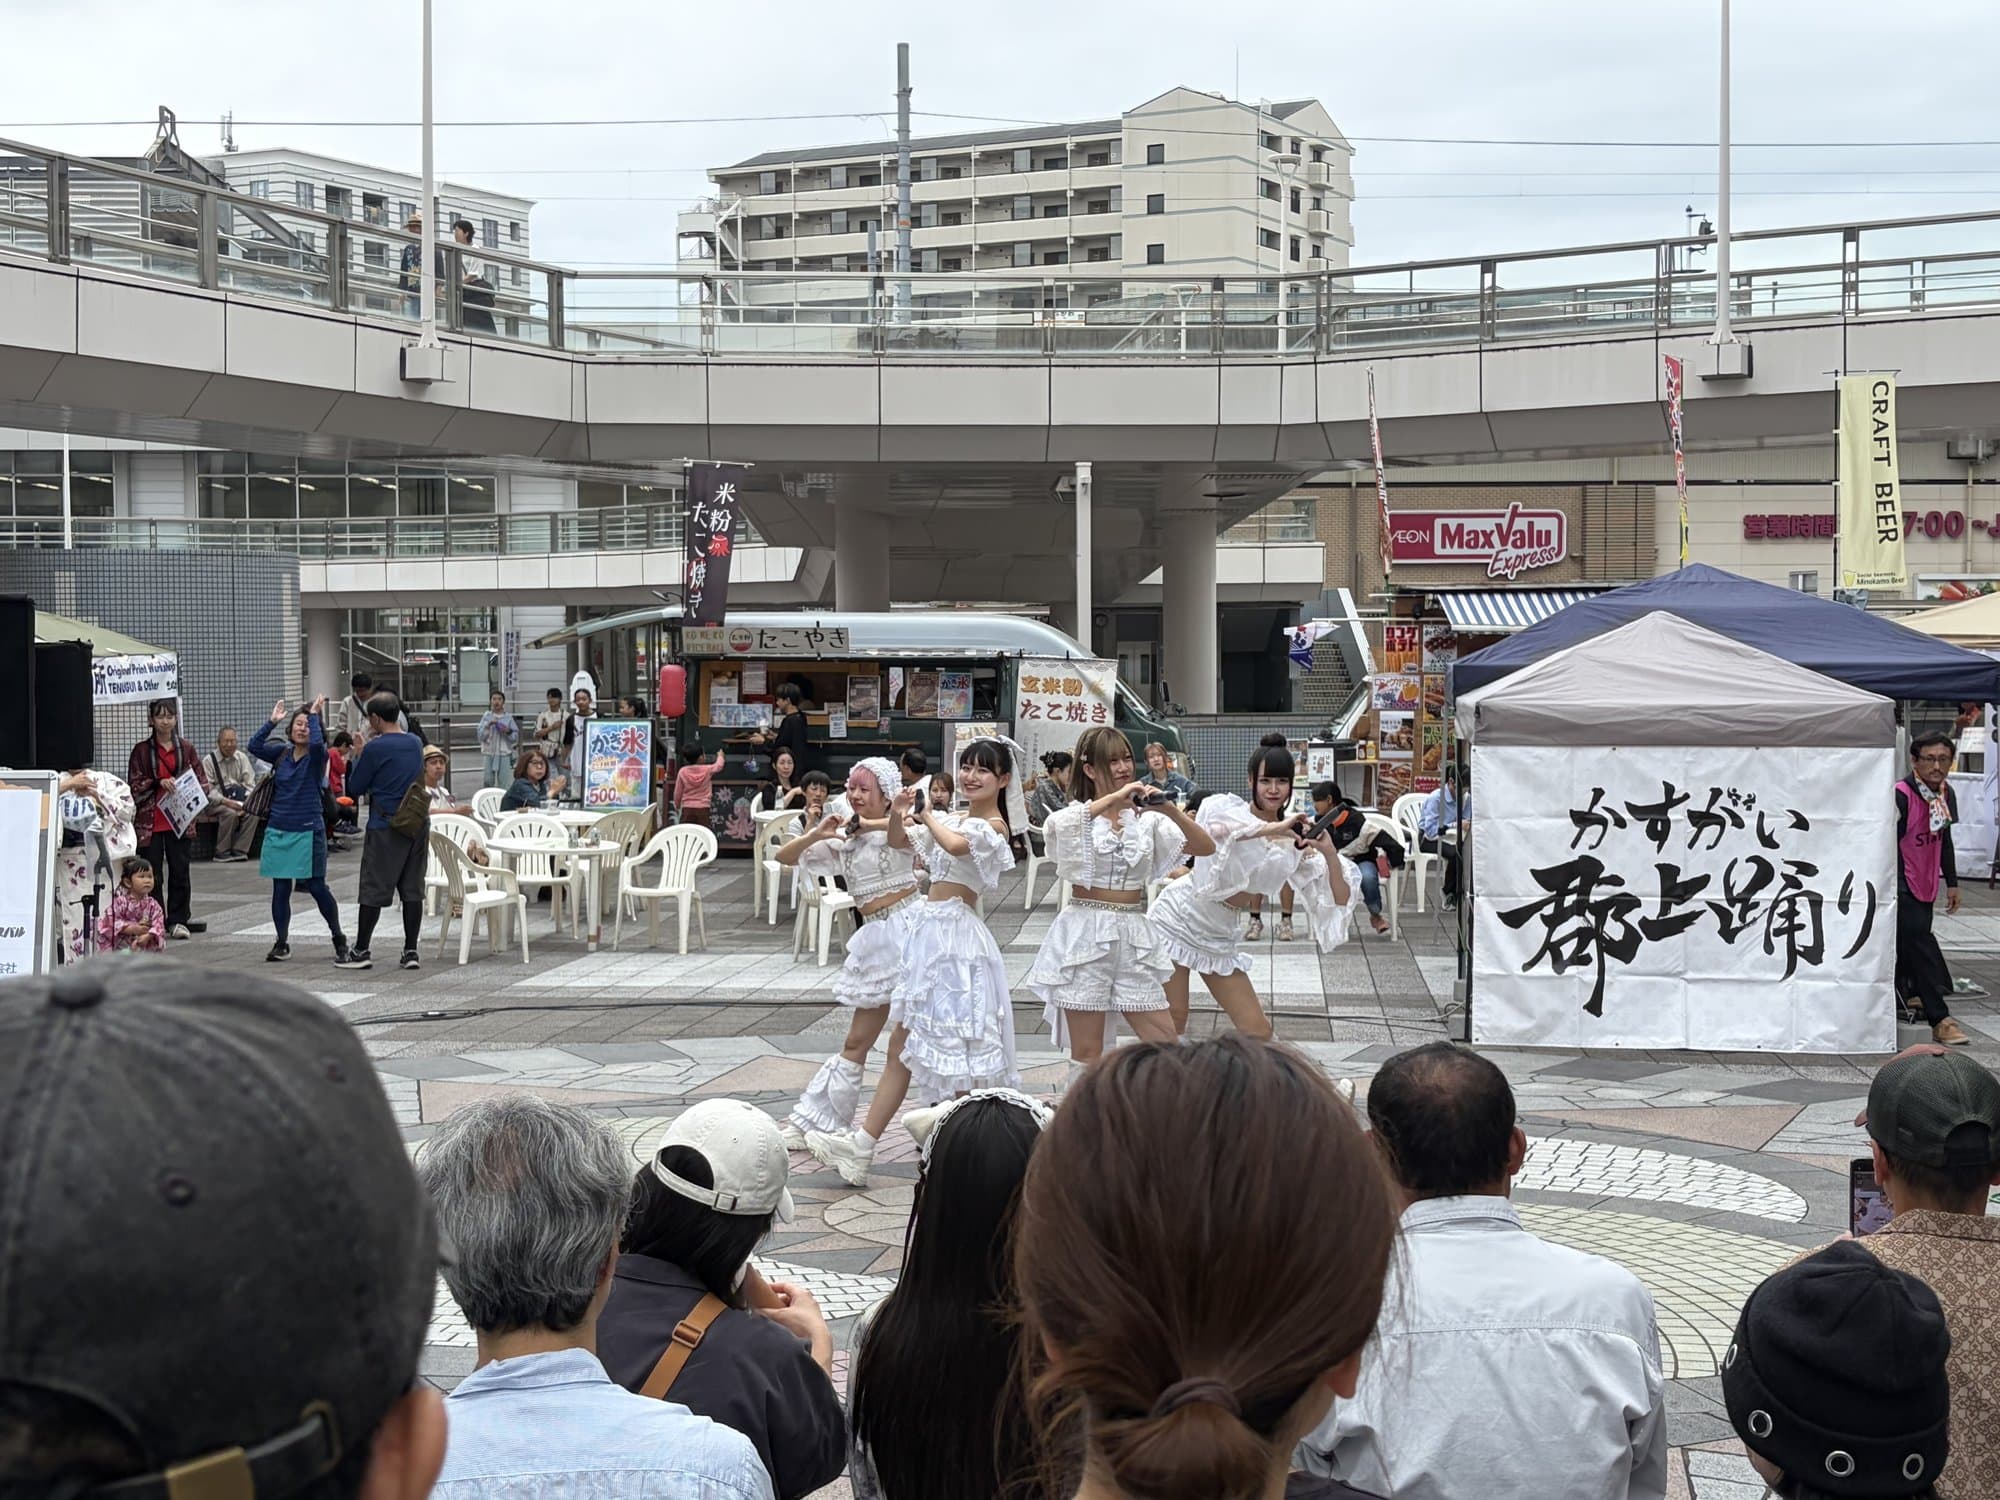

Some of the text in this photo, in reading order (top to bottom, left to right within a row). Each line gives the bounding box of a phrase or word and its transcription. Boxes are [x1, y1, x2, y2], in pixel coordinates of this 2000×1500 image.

[1872, 380, 1899, 544] CRAFT BEER
[710, 481, 736, 532] 米粉
[1440, 503, 1553, 549] MaxValu
[1743, 514, 1834, 539] 営業時間
[688, 501, 711, 619] たこ焼き
[1489, 546, 1557, 576] Express
[757, 628, 845, 649] たこやき
[1020, 699, 1108, 723] たこ焼き
[591, 726, 647, 755] かき氷
[1569, 780, 1810, 854] かすがい
[1496, 854, 1876, 1018] 郡上踊り
